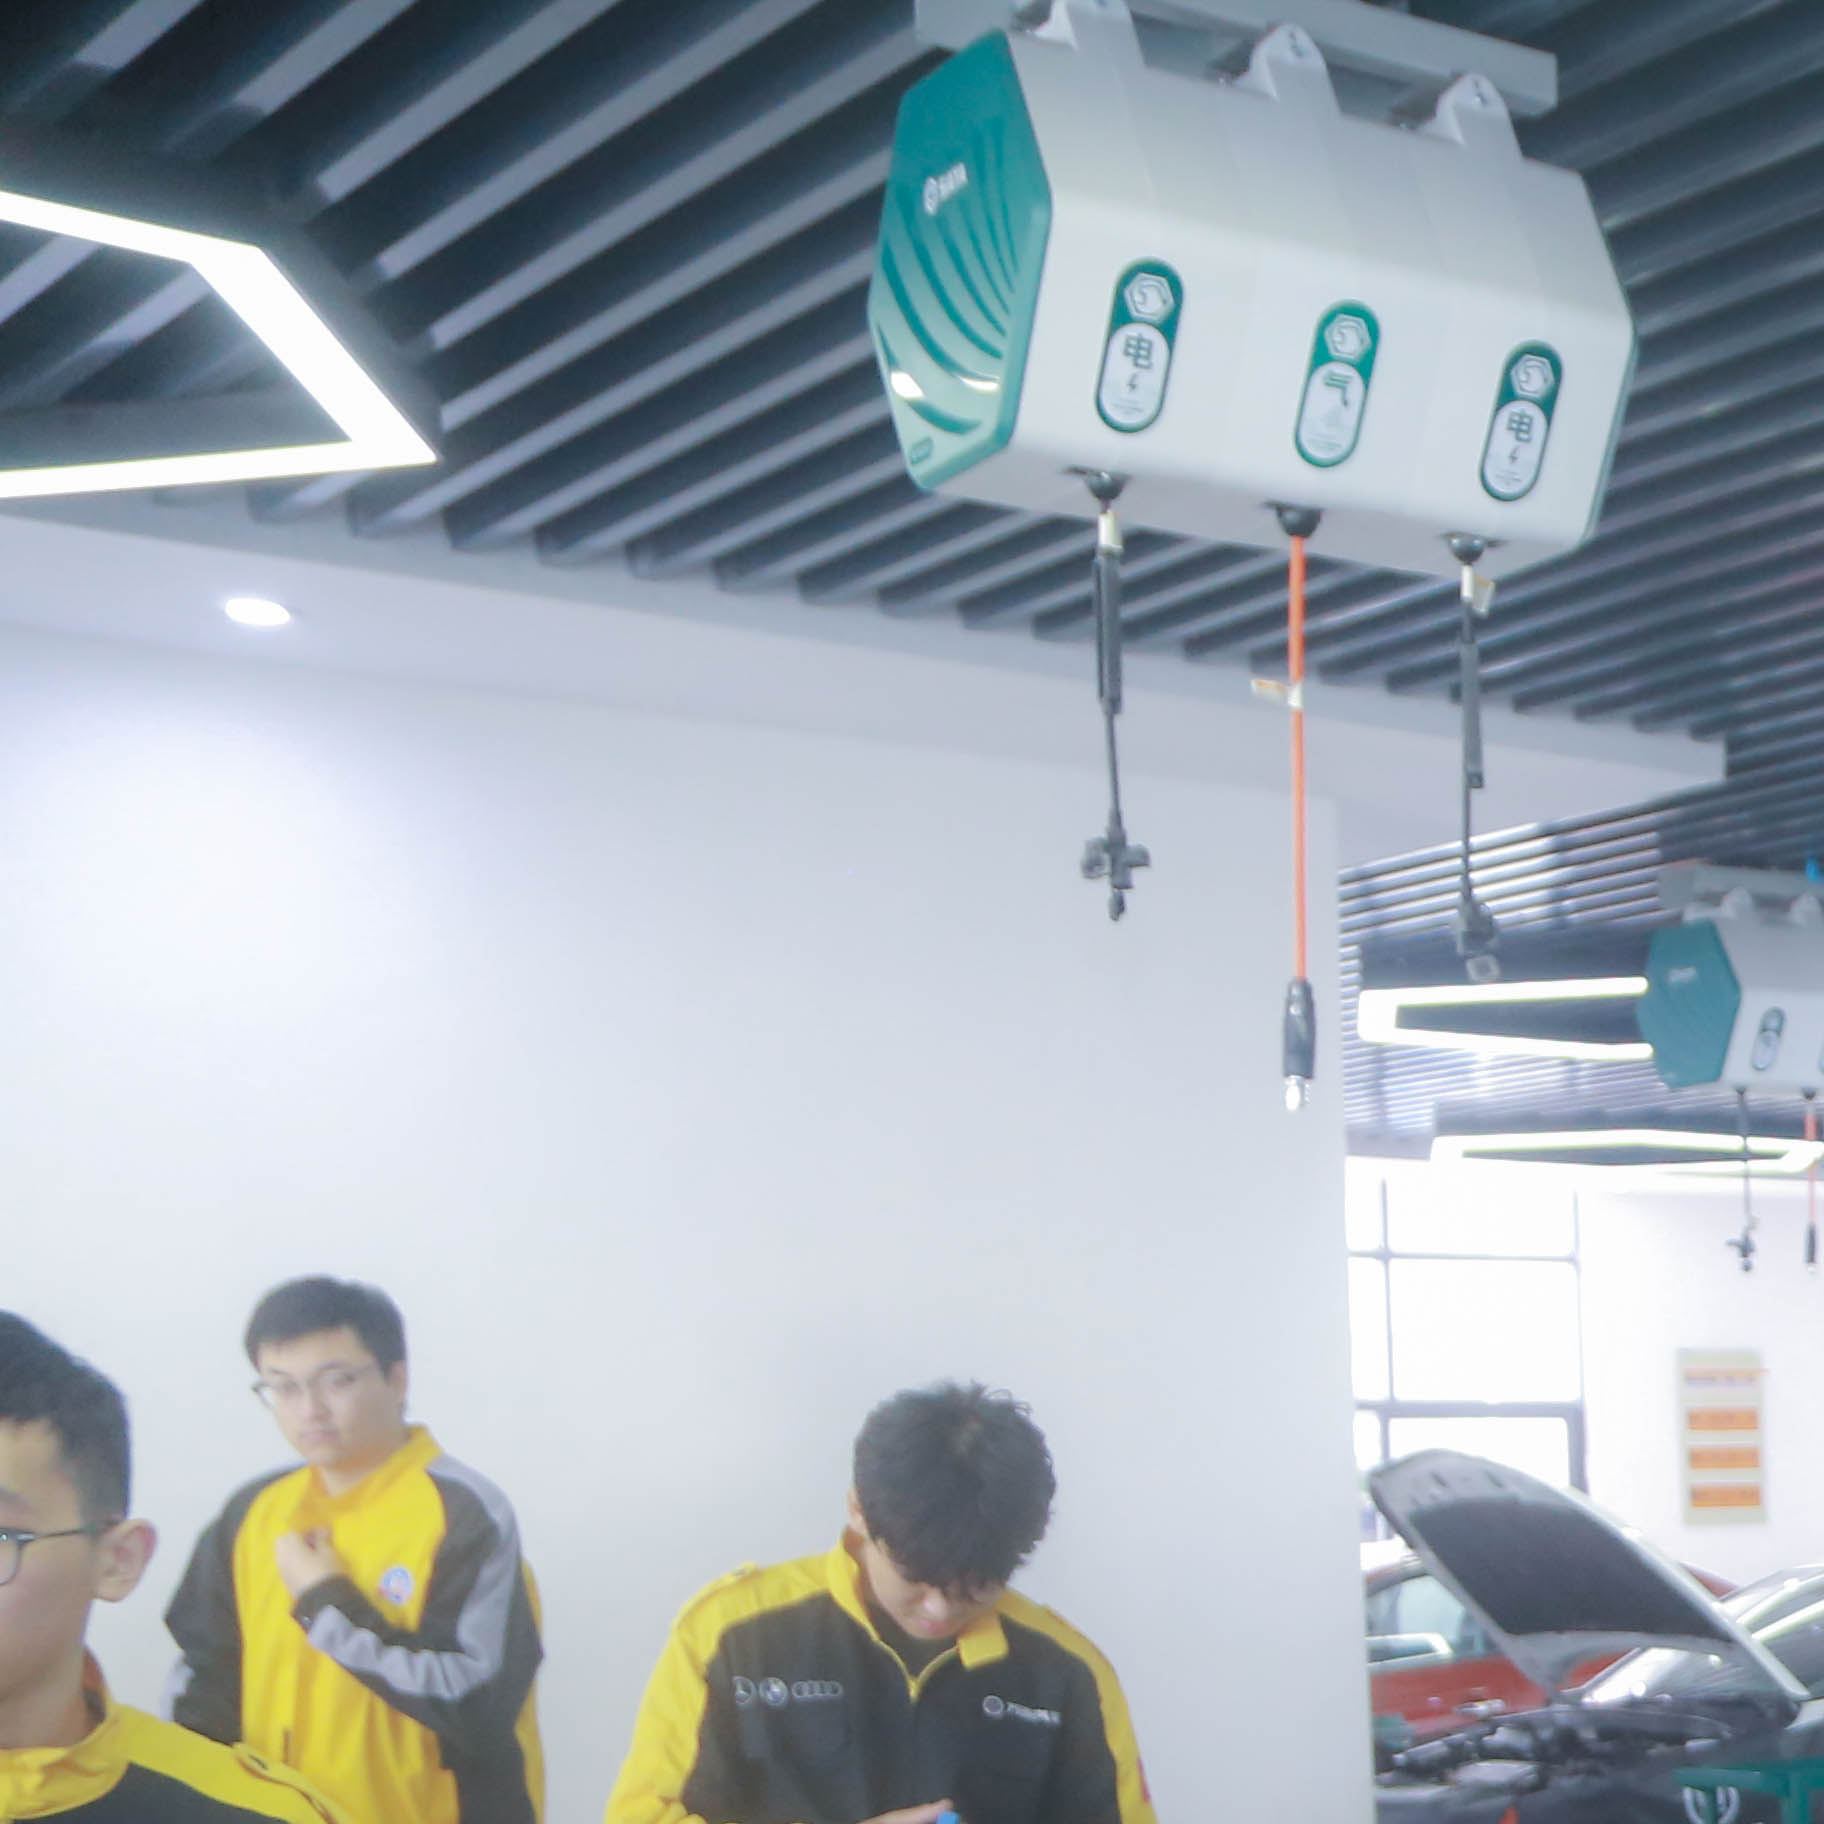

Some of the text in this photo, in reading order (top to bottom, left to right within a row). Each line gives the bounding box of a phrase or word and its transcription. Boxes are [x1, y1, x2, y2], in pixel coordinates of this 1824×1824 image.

[1122, 332, 1154, 371] 电
[1323, 369, 1353, 408] 气
[1506, 407, 1535, 444] 电
